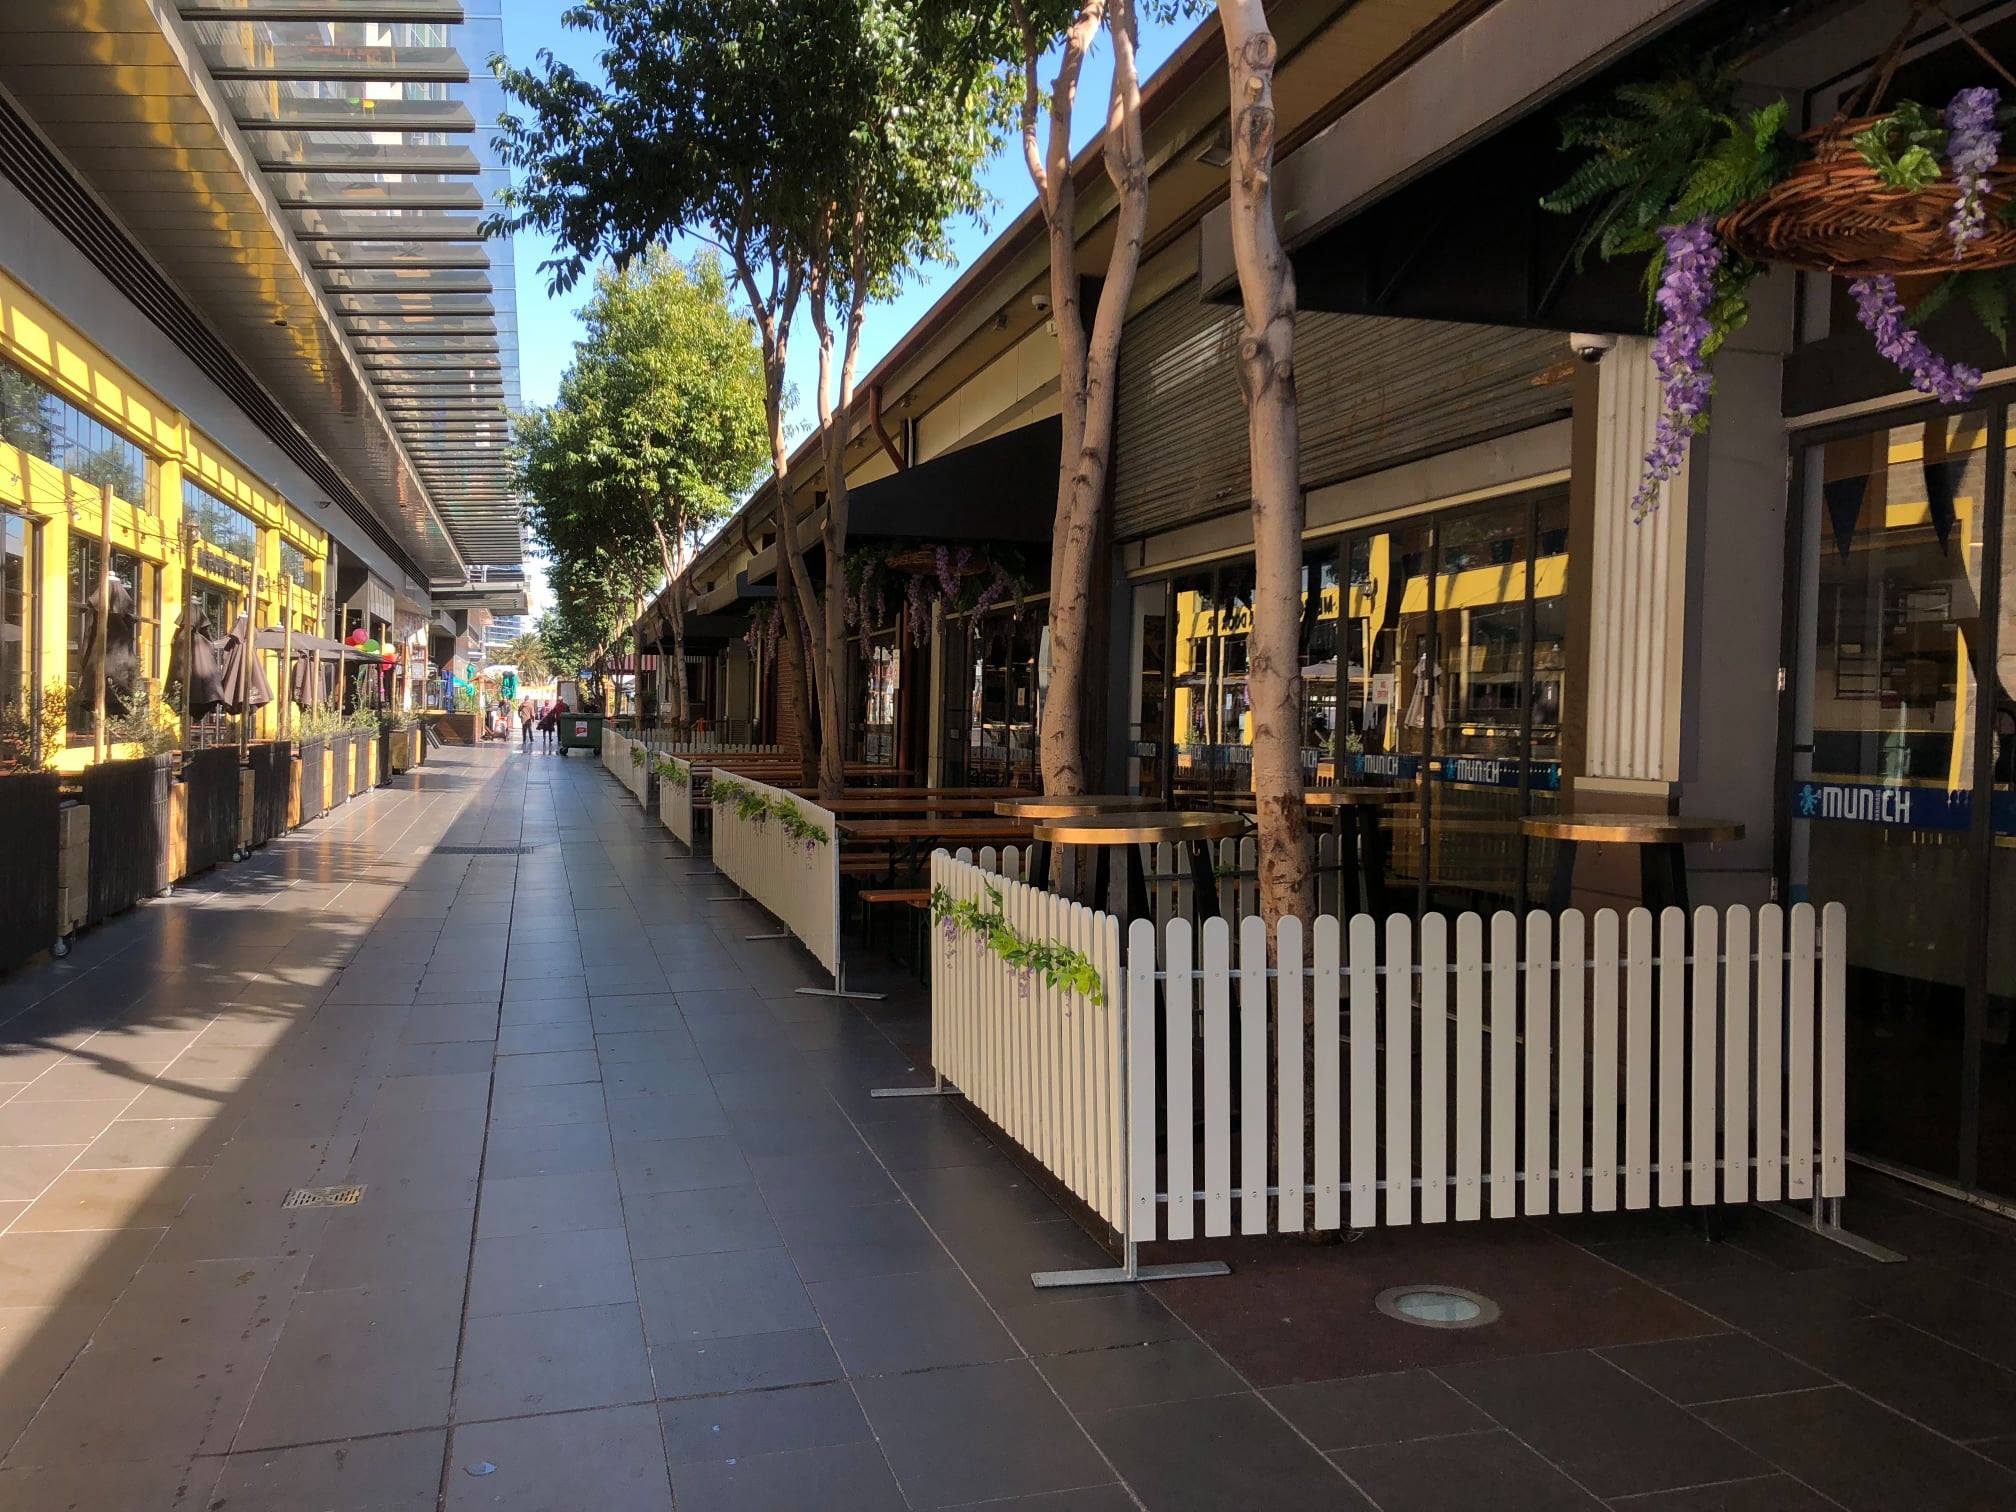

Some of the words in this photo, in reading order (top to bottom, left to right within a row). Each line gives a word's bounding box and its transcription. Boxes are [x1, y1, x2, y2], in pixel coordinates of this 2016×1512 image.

[1364, 754, 1399, 775] MUNICH
[1456, 758, 1500, 784] MUNICH
[1822, 786, 1911, 824] MUNICH
